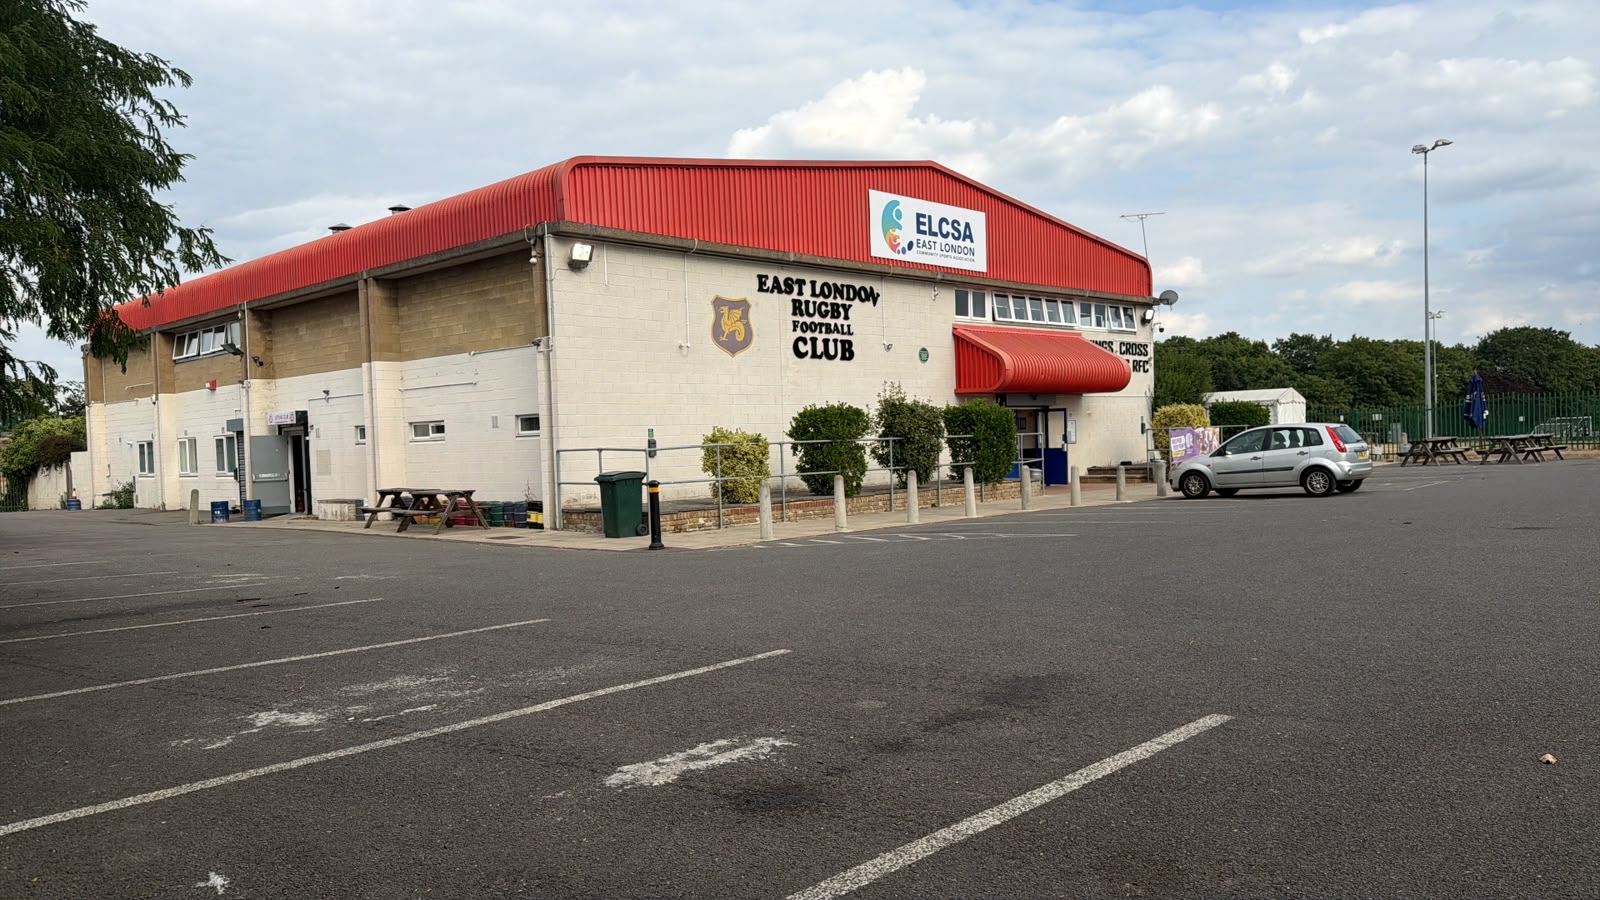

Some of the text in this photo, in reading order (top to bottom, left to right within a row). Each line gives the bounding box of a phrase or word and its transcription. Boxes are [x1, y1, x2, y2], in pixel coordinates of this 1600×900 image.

[916, 212, 974, 243] ELCSA
[916, 238, 975, 256] EAST LONDON
[757, 274, 880, 307] EAST LONDON
[791, 299, 853, 321] RUGBY
[792, 320, 854, 337] FOOTBALL
[792, 336, 855, 361] CLUB
[1119, 341, 1149, 357] CROSS
[1132, 359, 1149, 373] RFC
